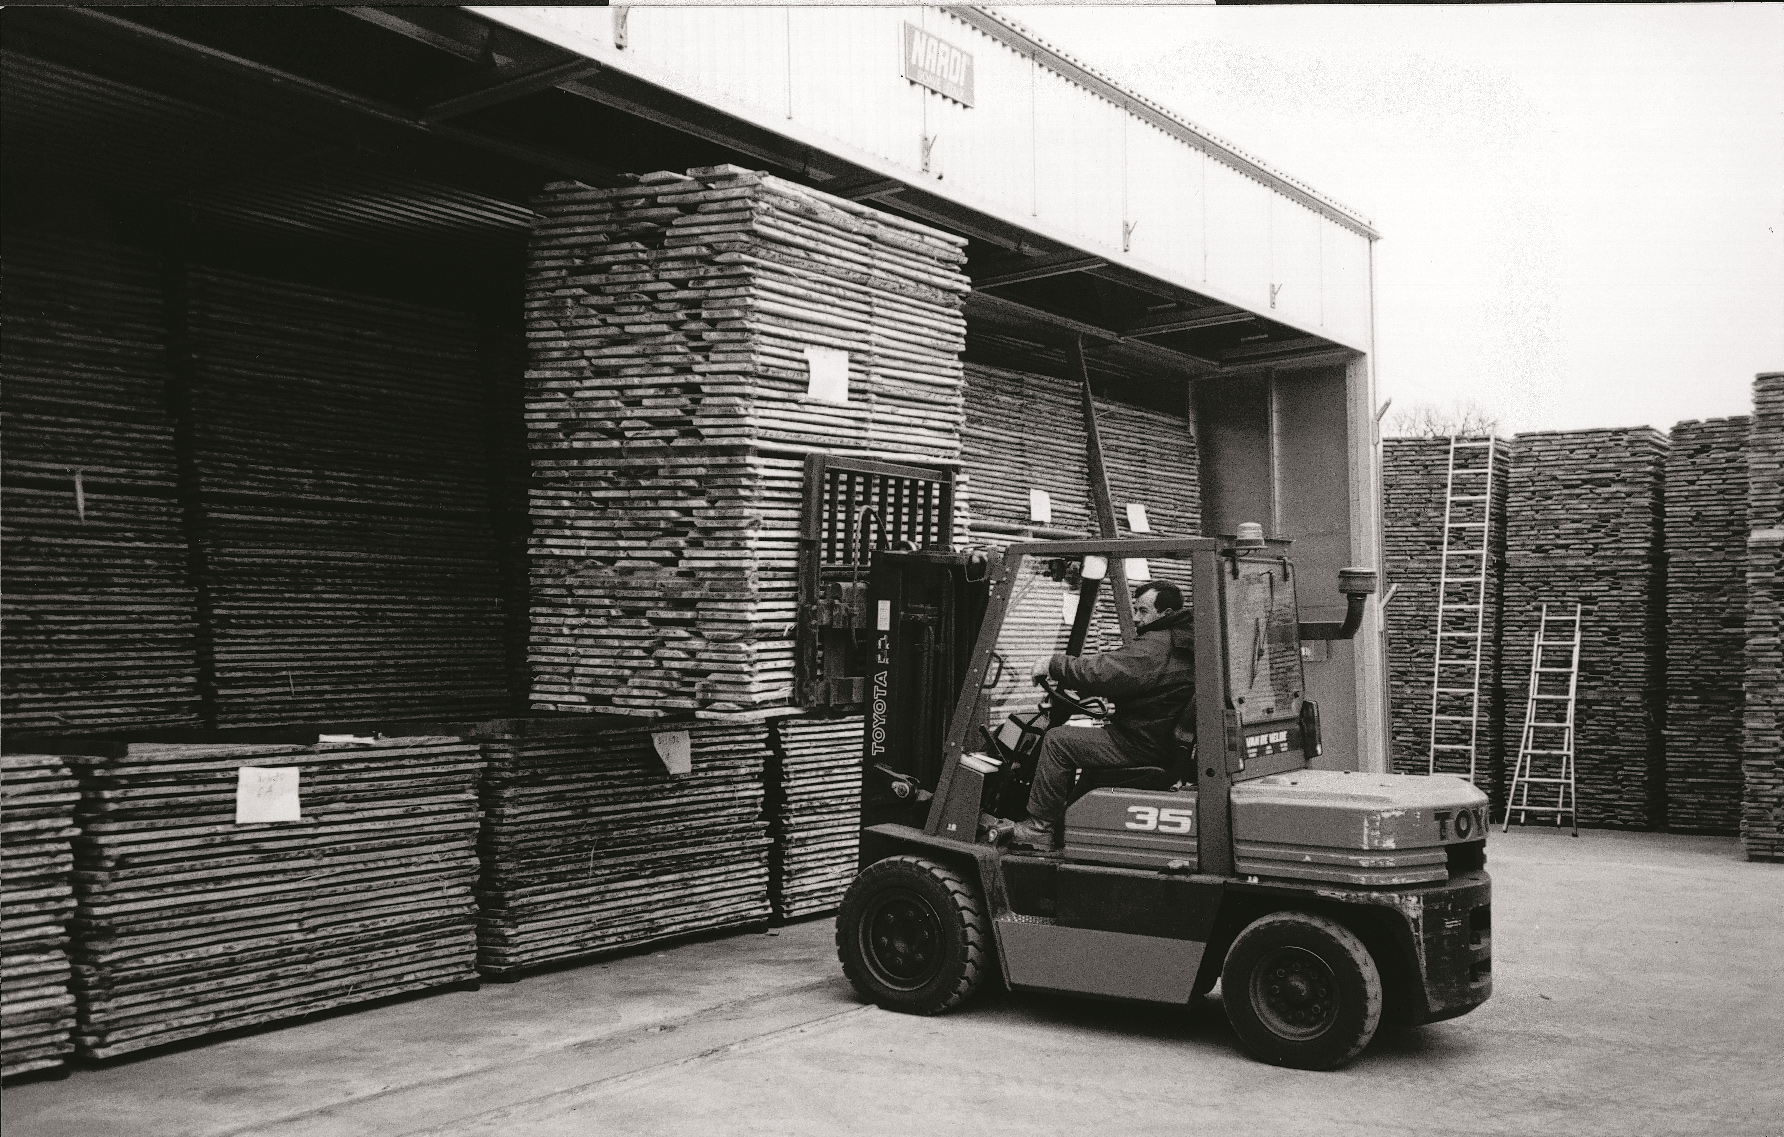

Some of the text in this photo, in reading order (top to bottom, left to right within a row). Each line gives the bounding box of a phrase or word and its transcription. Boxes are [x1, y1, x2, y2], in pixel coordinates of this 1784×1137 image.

[911, 30, 968, 87] NARDI
[872, 670, 888, 756] TOYOTA
[1125, 806, 1193, 834] 35
[1434, 808, 1489, 840] TOY
